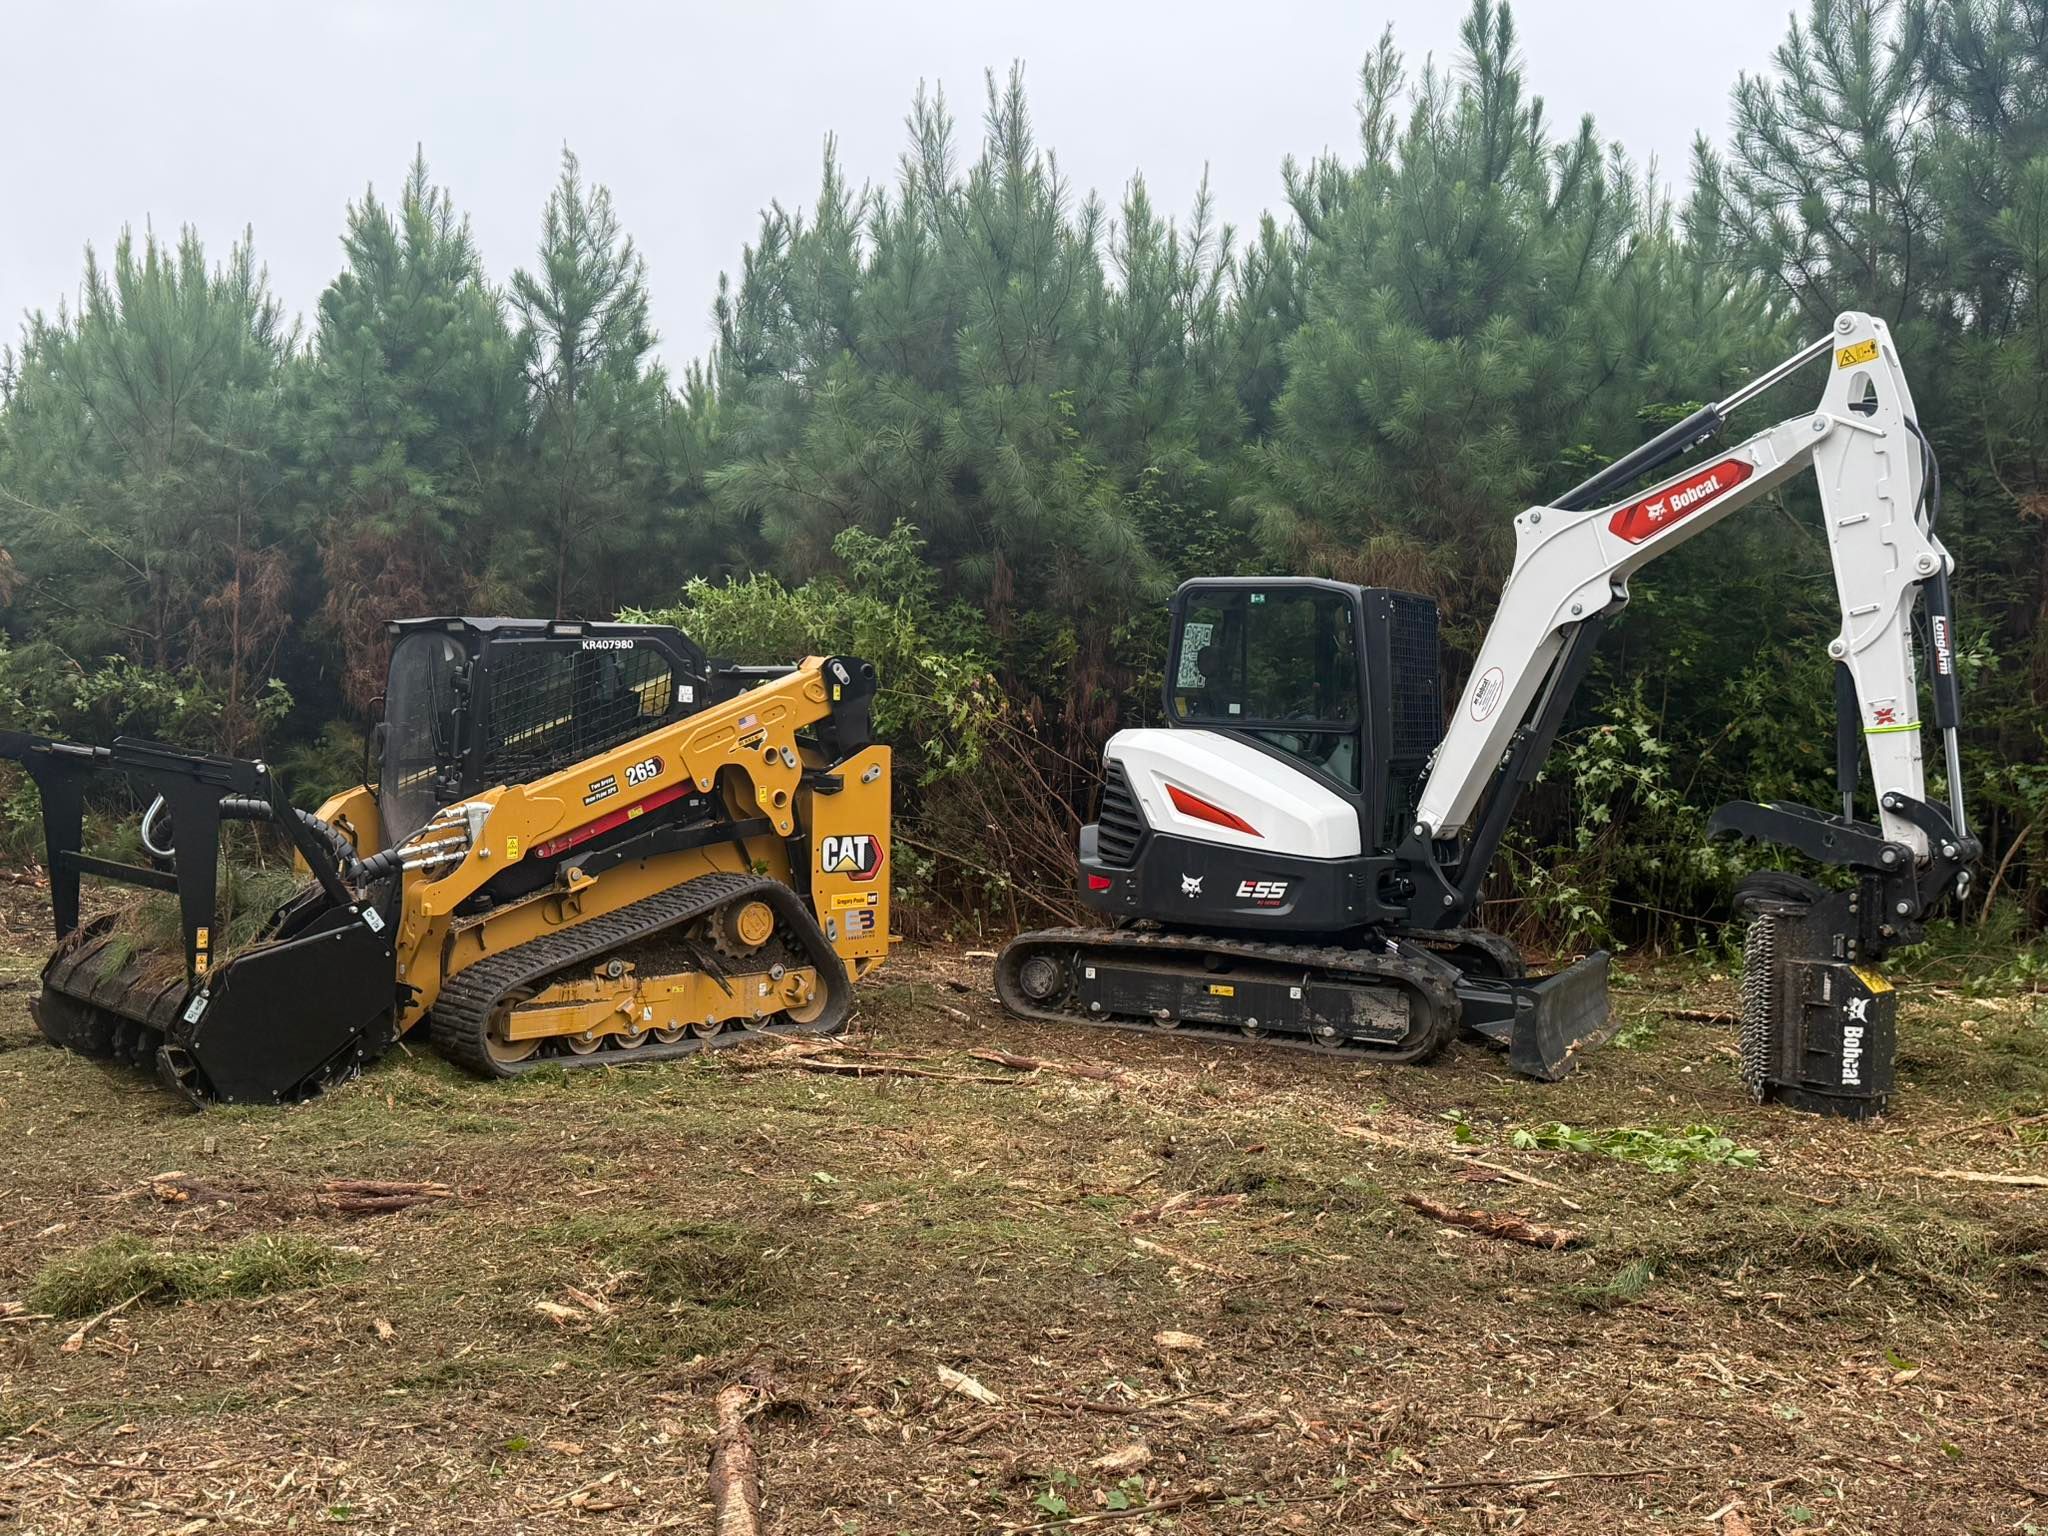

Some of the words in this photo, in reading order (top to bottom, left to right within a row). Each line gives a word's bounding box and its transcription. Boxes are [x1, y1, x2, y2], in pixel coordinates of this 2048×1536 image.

[1670, 475, 1720, 512] Bobcat
[582, 640, 634, 650] KR407980
[1934, 615, 1950, 675] LongArm
[625, 758, 657, 787] 265
[822, 836, 868, 872] CAT
[1235, 880, 1289, 899] E55
[1841, 1025, 1864, 1086] Bobcat
